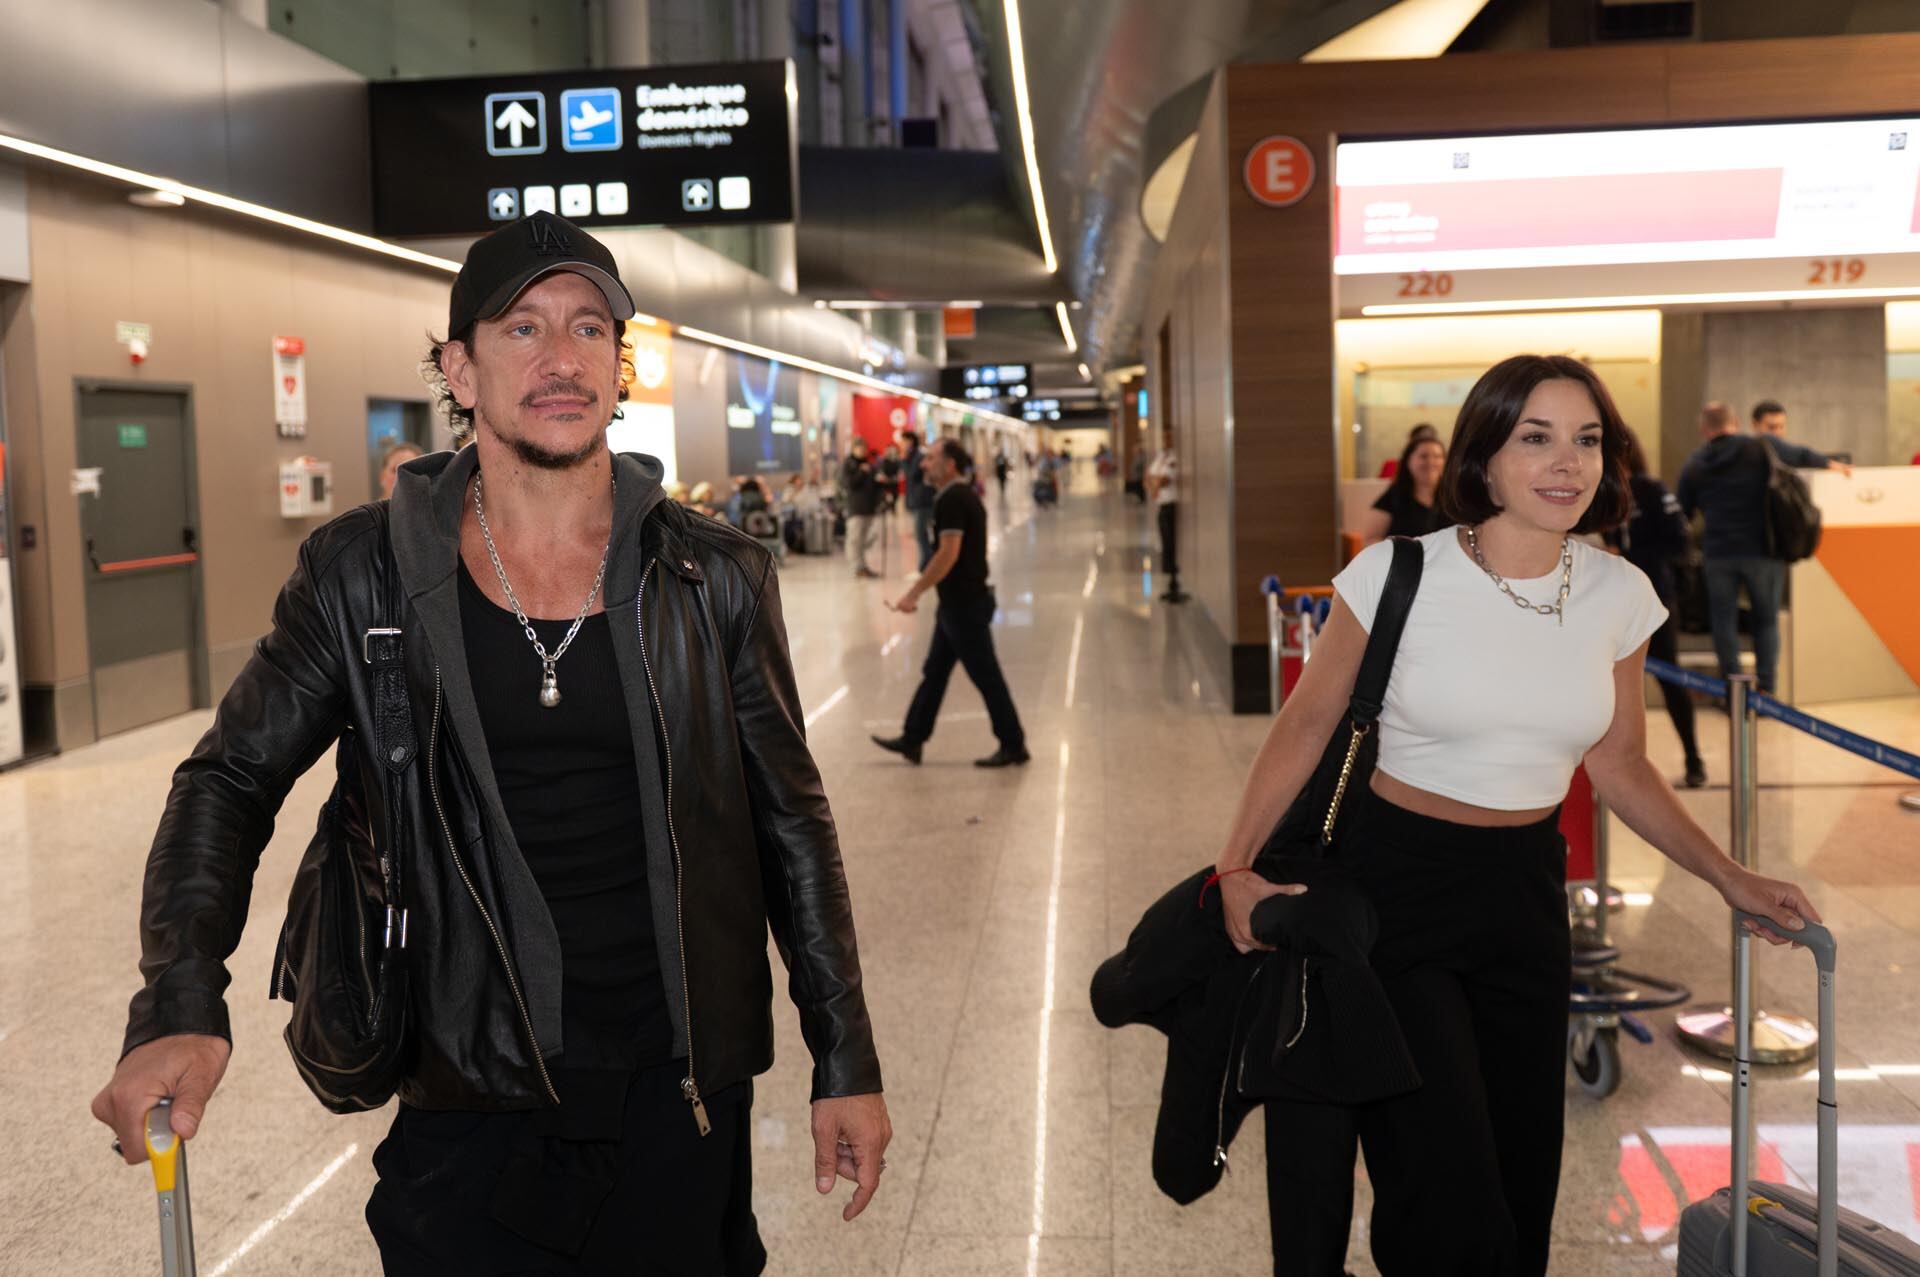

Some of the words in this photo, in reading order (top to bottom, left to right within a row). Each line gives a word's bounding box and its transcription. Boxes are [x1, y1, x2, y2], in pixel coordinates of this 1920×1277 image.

[636, 83, 746, 108] Embarque
[637, 106, 749, 131] doméstico
[638, 133, 692, 149] Domestic
[1265, 149, 1294, 192] E
[528, 219, 576, 257] LA
[1806, 257, 1867, 286] 219
[1397, 273, 1454, 298] 220
